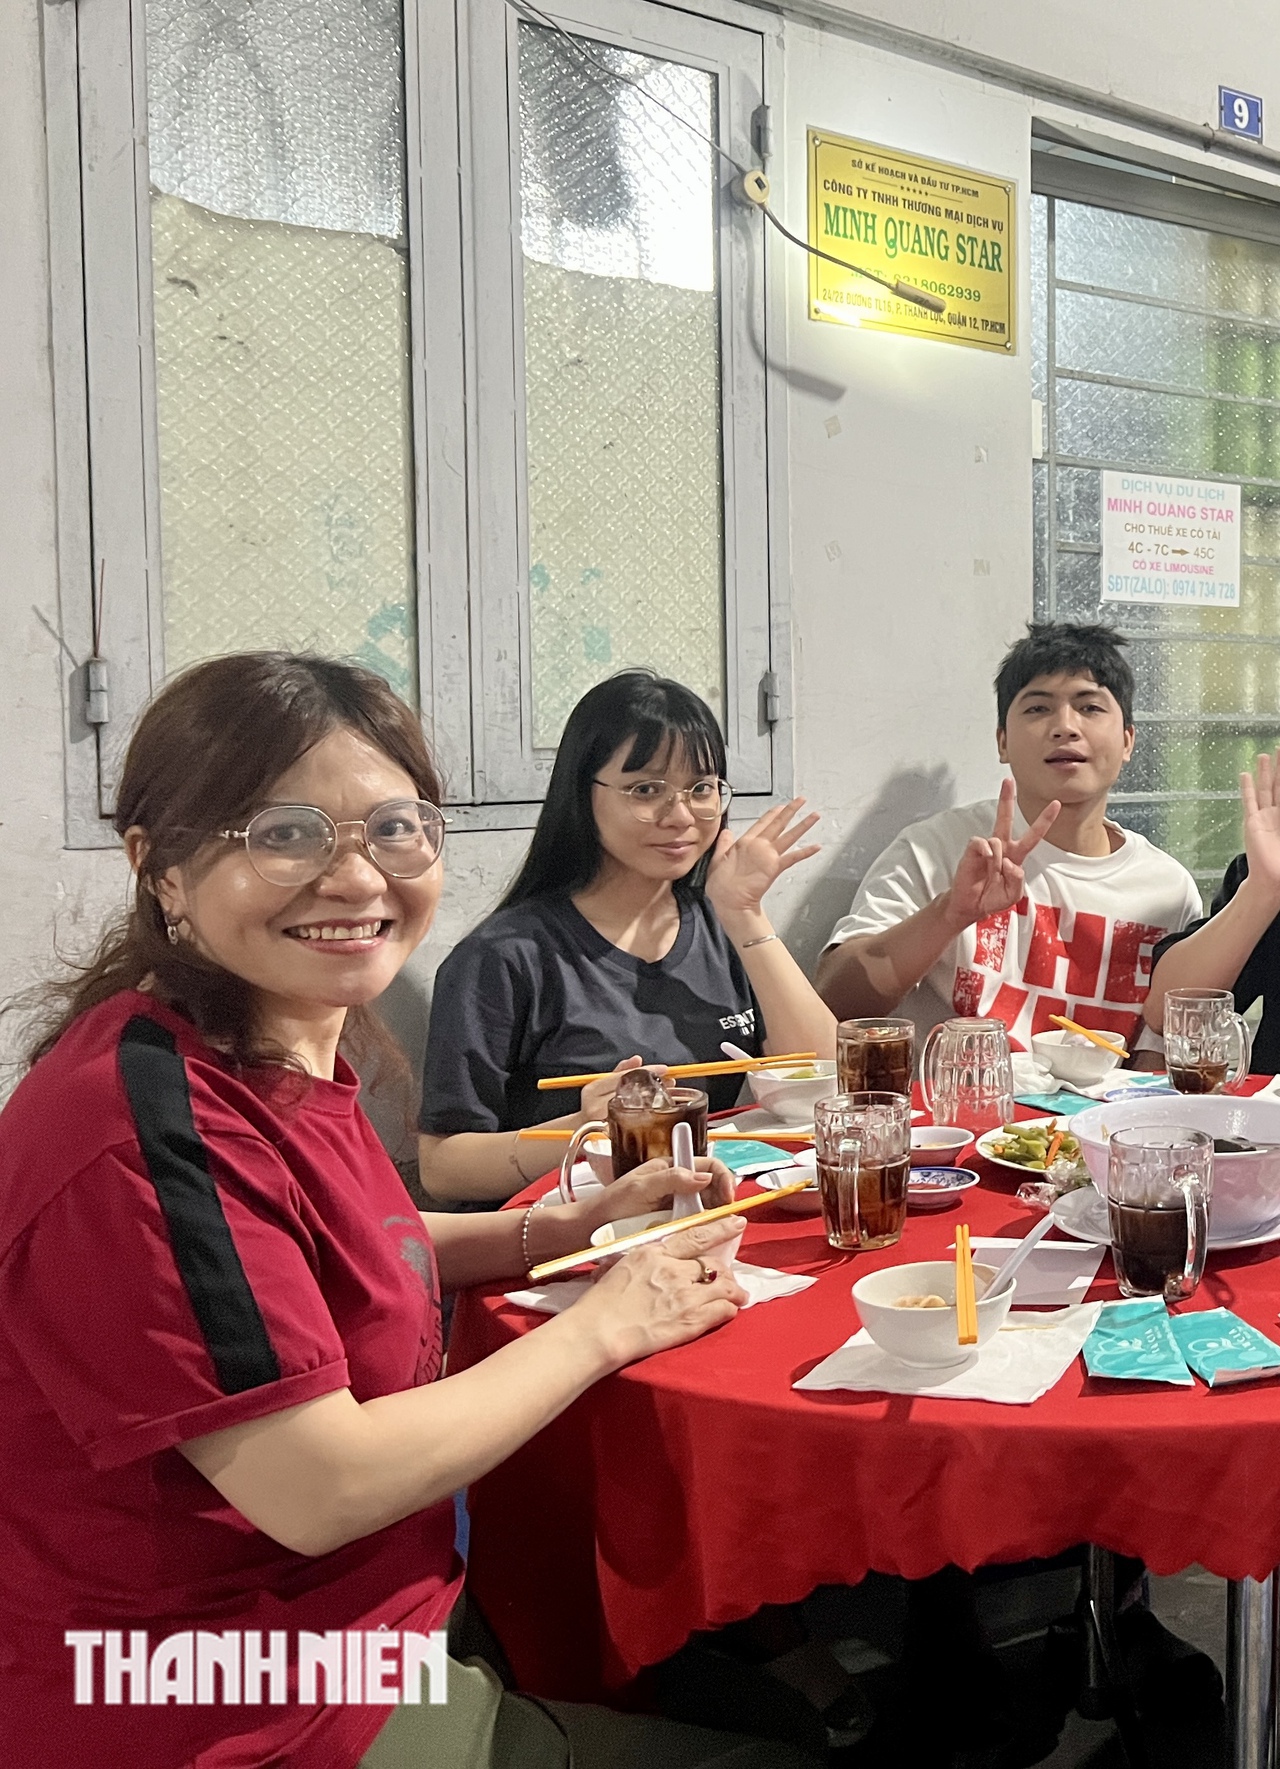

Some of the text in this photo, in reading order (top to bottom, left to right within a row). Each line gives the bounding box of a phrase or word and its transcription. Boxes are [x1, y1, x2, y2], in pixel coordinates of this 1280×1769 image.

[1233, 98, 1249, 129] 9
[878, 166, 906, 180] HOẠCH
[908, 172, 919, 183] VÀ
[939, 180, 950, 191] TƯ
[951, 183, 979, 198] TP.HCM
[823, 178, 1004, 235] CÔNG TY TNHH THƯƠNG MẠI DỊCH VỤ
[824, 202, 1003, 273] MINH QUANG STAR
[947, 311, 967, 329] QUẬN
[969, 318, 979, 332] 12,
[981, 320, 1006, 335] TP.HCM
[1121, 478, 1225, 502] DỊCH VỤ DU LỊCH
[1107, 497, 1234, 523] MINH QUANG STAR
[1124, 522, 1145, 534] CHO
[1148, 524, 1173, 536] THUÊ
[1176, 527, 1187, 537] XE
[1190, 528, 1204, 539] CÓ
[1128, 541, 1143, 554] 4C
[1155, 544, 1169, 556] 7C
[1193, 547, 1215, 560] 45C
[1132, 560, 1215, 576] CÓ XE LIMOUSINE
[1172, 579, 1196, 596] 0974
[1199, 581, 1216, 597] 734
[1219, 583, 1236, 599] 728
